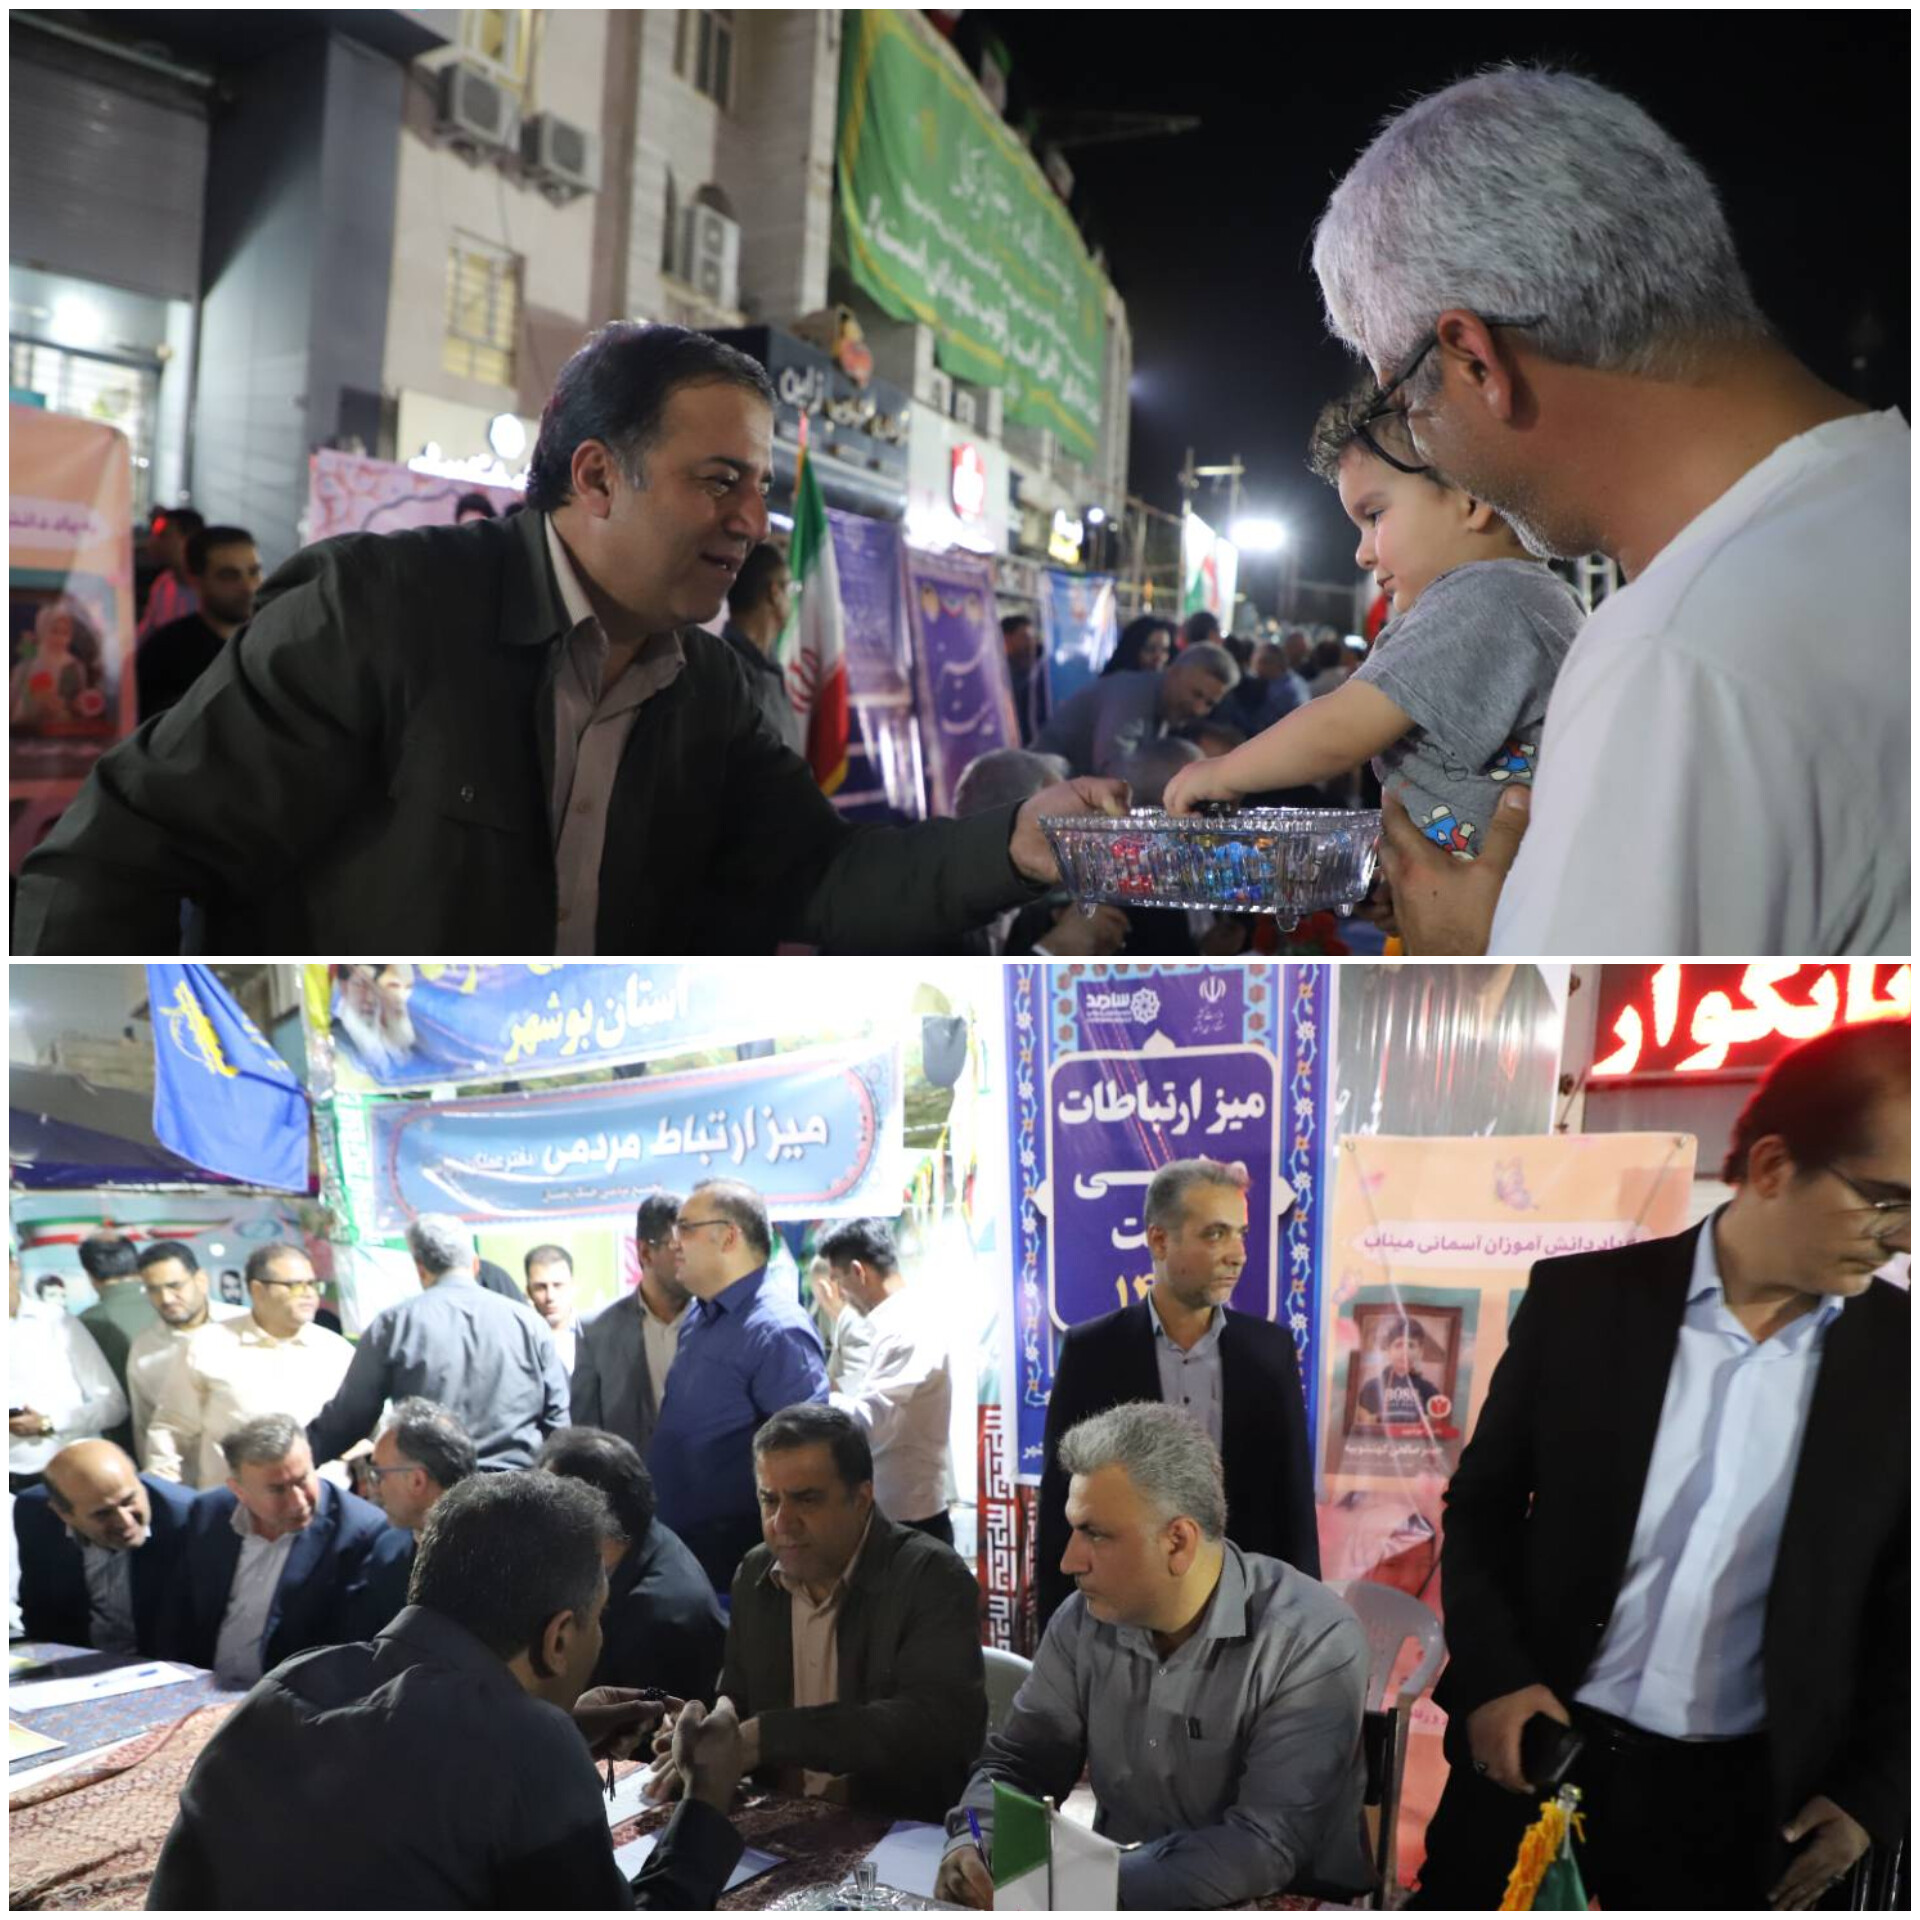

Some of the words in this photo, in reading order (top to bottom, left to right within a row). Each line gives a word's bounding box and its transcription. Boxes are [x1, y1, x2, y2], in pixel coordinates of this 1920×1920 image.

[503, 990, 594, 1065] بوشهر
[596, 972, 688, 1049] استان
[1058, 1078, 1202, 1135] ارتباطات
[1205, 1088, 1266, 1134] میز
[541, 1132, 642, 1176] مردمی
[650, 1105, 757, 1166] ارتباط
[762, 1105, 829, 1164] میز
[1364, 1233, 1415, 1252] میناب
[1417, 1234, 1483, 1254] آسمانی
[1484, 1234, 1543, 1256] آموزان
[1544, 1235, 1594, 1255] دانش
